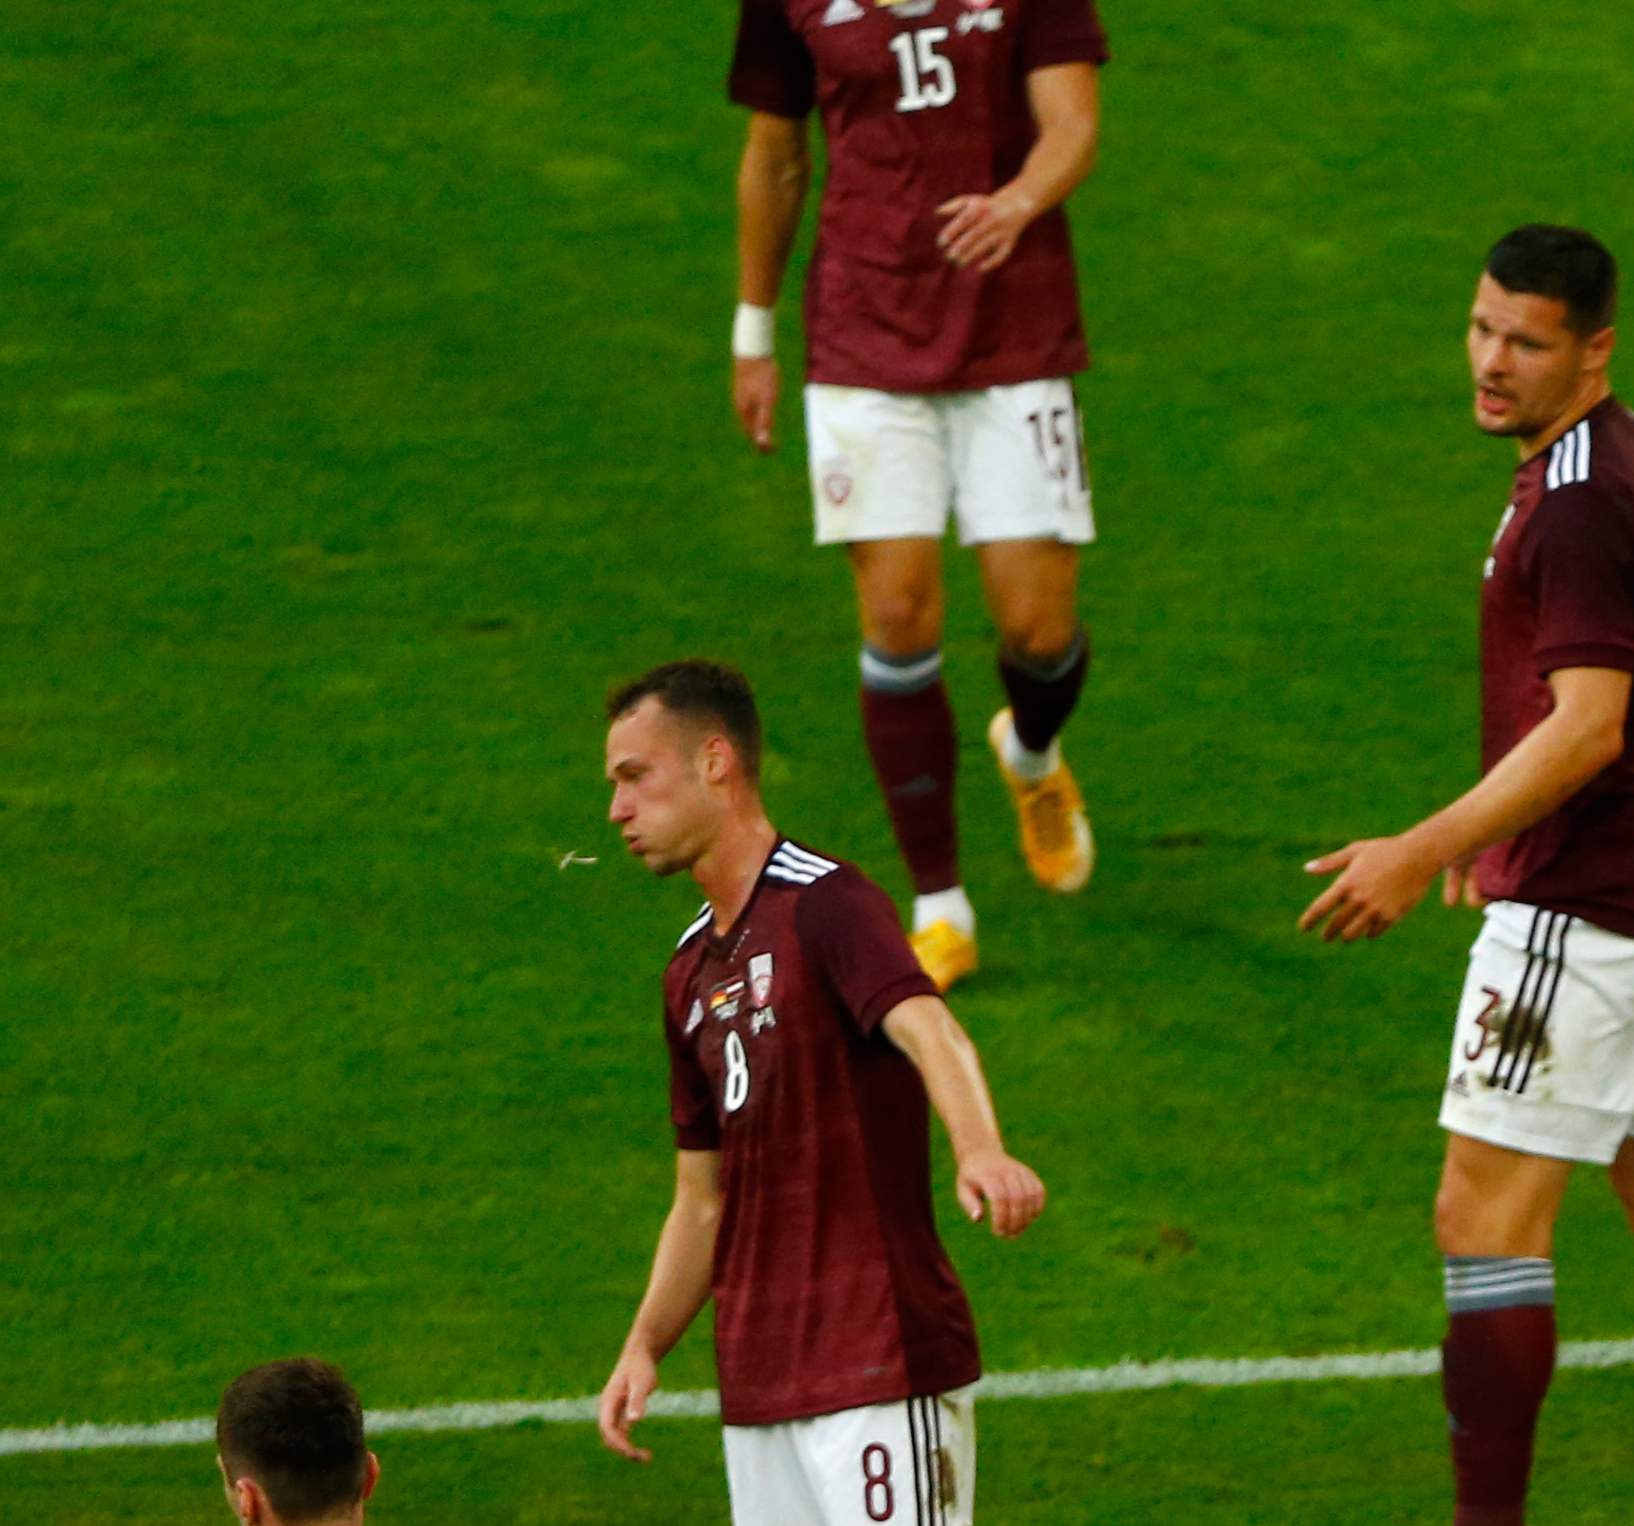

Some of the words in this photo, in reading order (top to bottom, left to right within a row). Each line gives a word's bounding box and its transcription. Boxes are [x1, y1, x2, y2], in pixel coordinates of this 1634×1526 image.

[888, 26, 957, 113] 15
[1464, 985, 1501, 1061] 3
[725, 1029, 749, 1113] 8
[863, 1442, 894, 1522] 8
